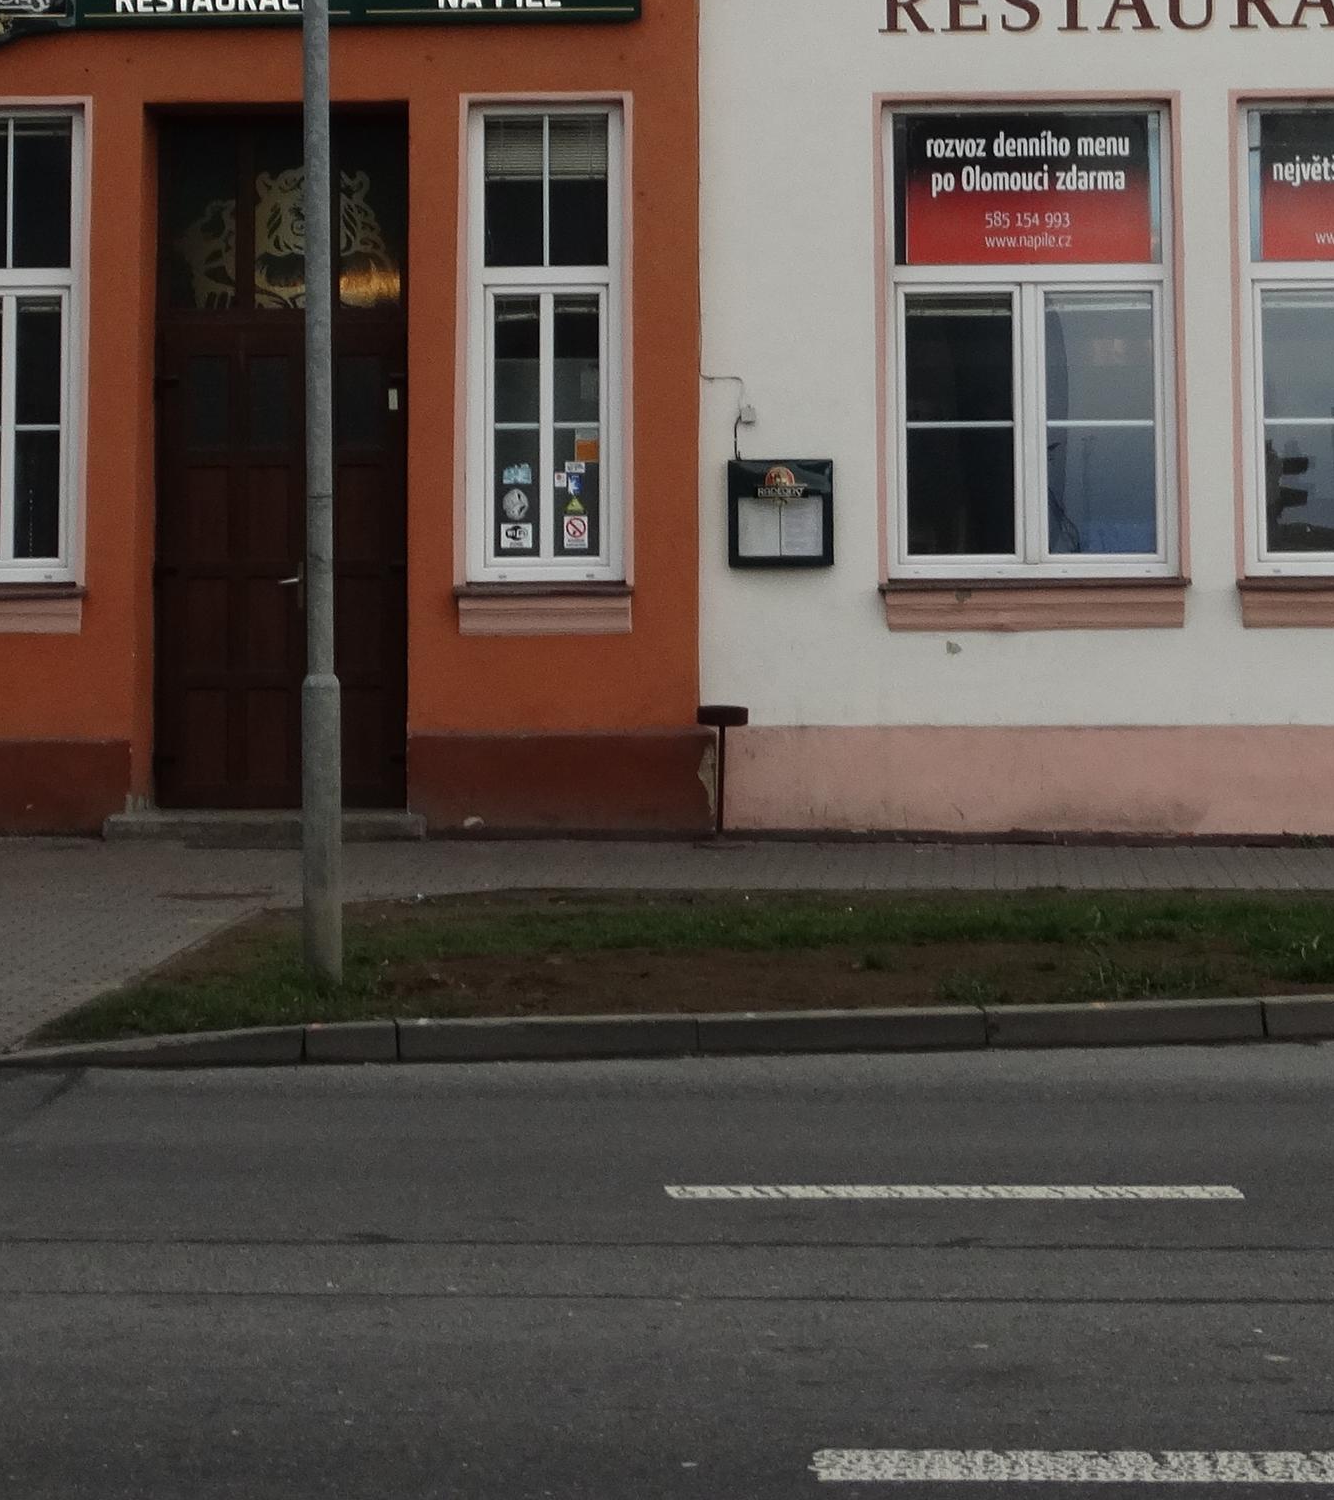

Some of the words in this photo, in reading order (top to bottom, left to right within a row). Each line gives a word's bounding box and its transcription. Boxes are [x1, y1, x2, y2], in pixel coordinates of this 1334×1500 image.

[926, 137, 986, 158] rozvoz
[993, 130, 1070, 157] denního
[1077, 136, 1130, 157] menu
[932, 171, 955, 198] po
[961, 164, 1049, 191] Olomouci
[1055, 164, 1125, 191] zdarma
[985, 211, 1011, 229] 585
[1016, 212, 1040, 229] 154
[1045, 212, 1071, 229] 993
[985, 233, 1072, 250] www.napile.cz
